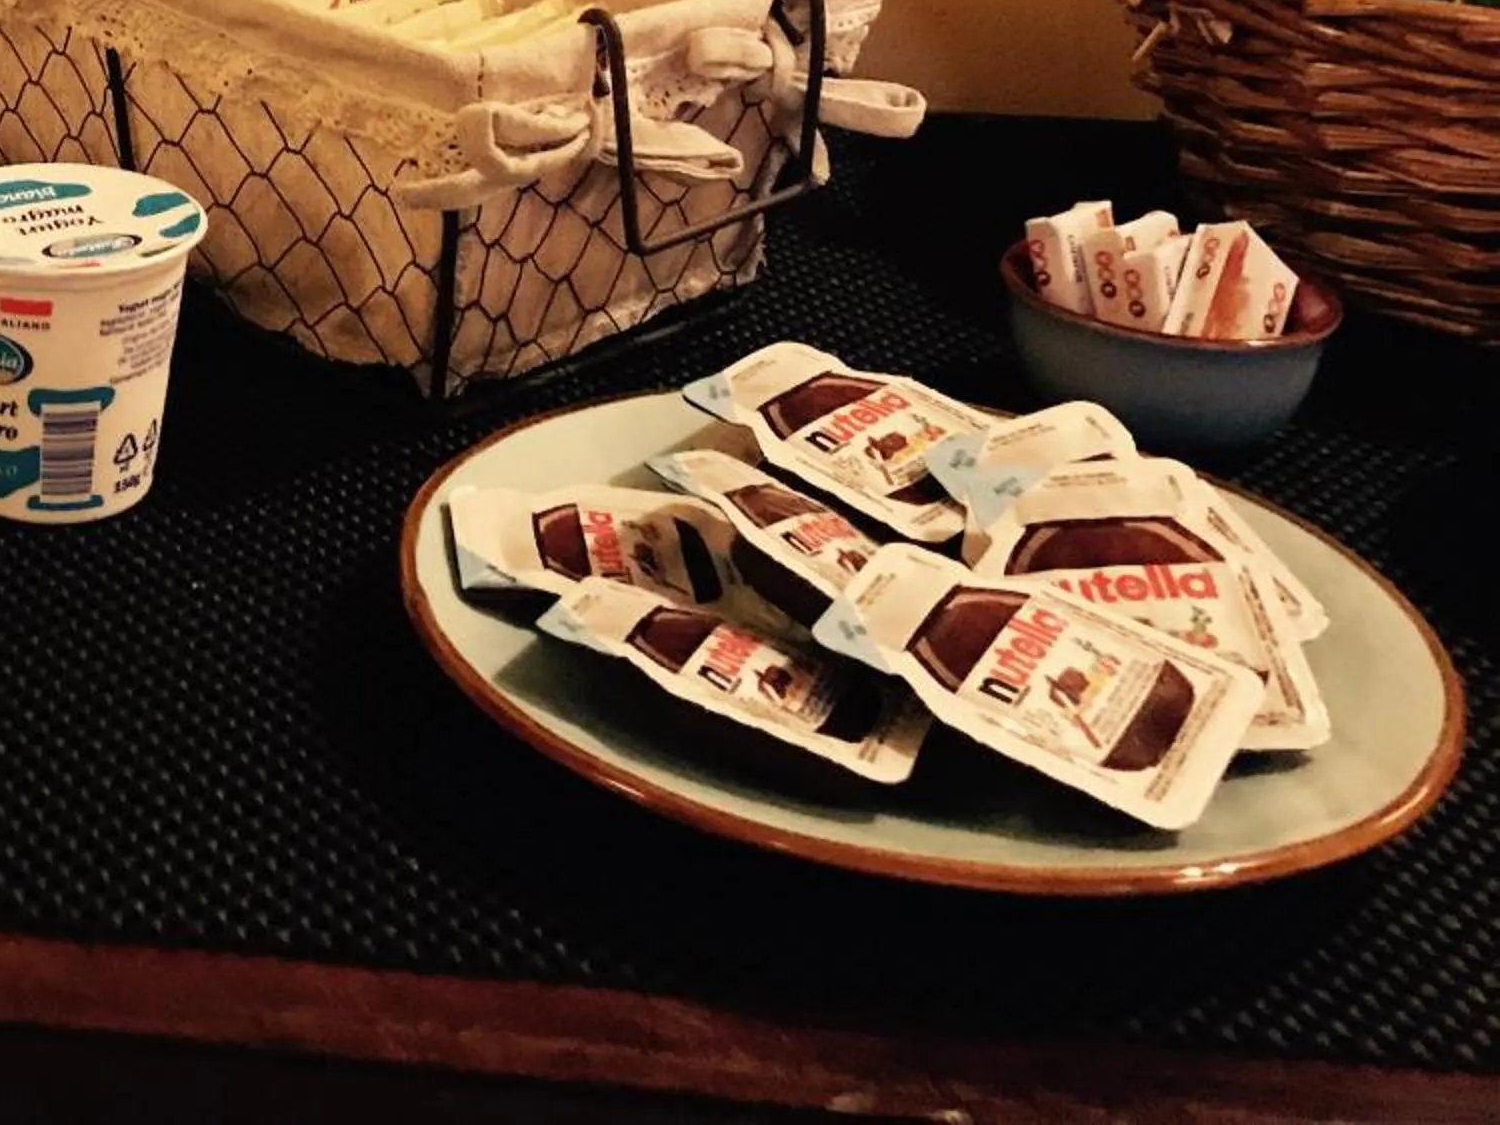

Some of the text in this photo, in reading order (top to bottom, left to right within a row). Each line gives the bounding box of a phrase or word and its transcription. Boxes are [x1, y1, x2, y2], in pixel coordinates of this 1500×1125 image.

[2, 204, 86, 224] magro
[19, 215, 105, 236] Yogurt
[804, 391, 913, 453] nutella
[1057, 562, 1219, 605] utella
[979, 608, 1069, 704] nutella
